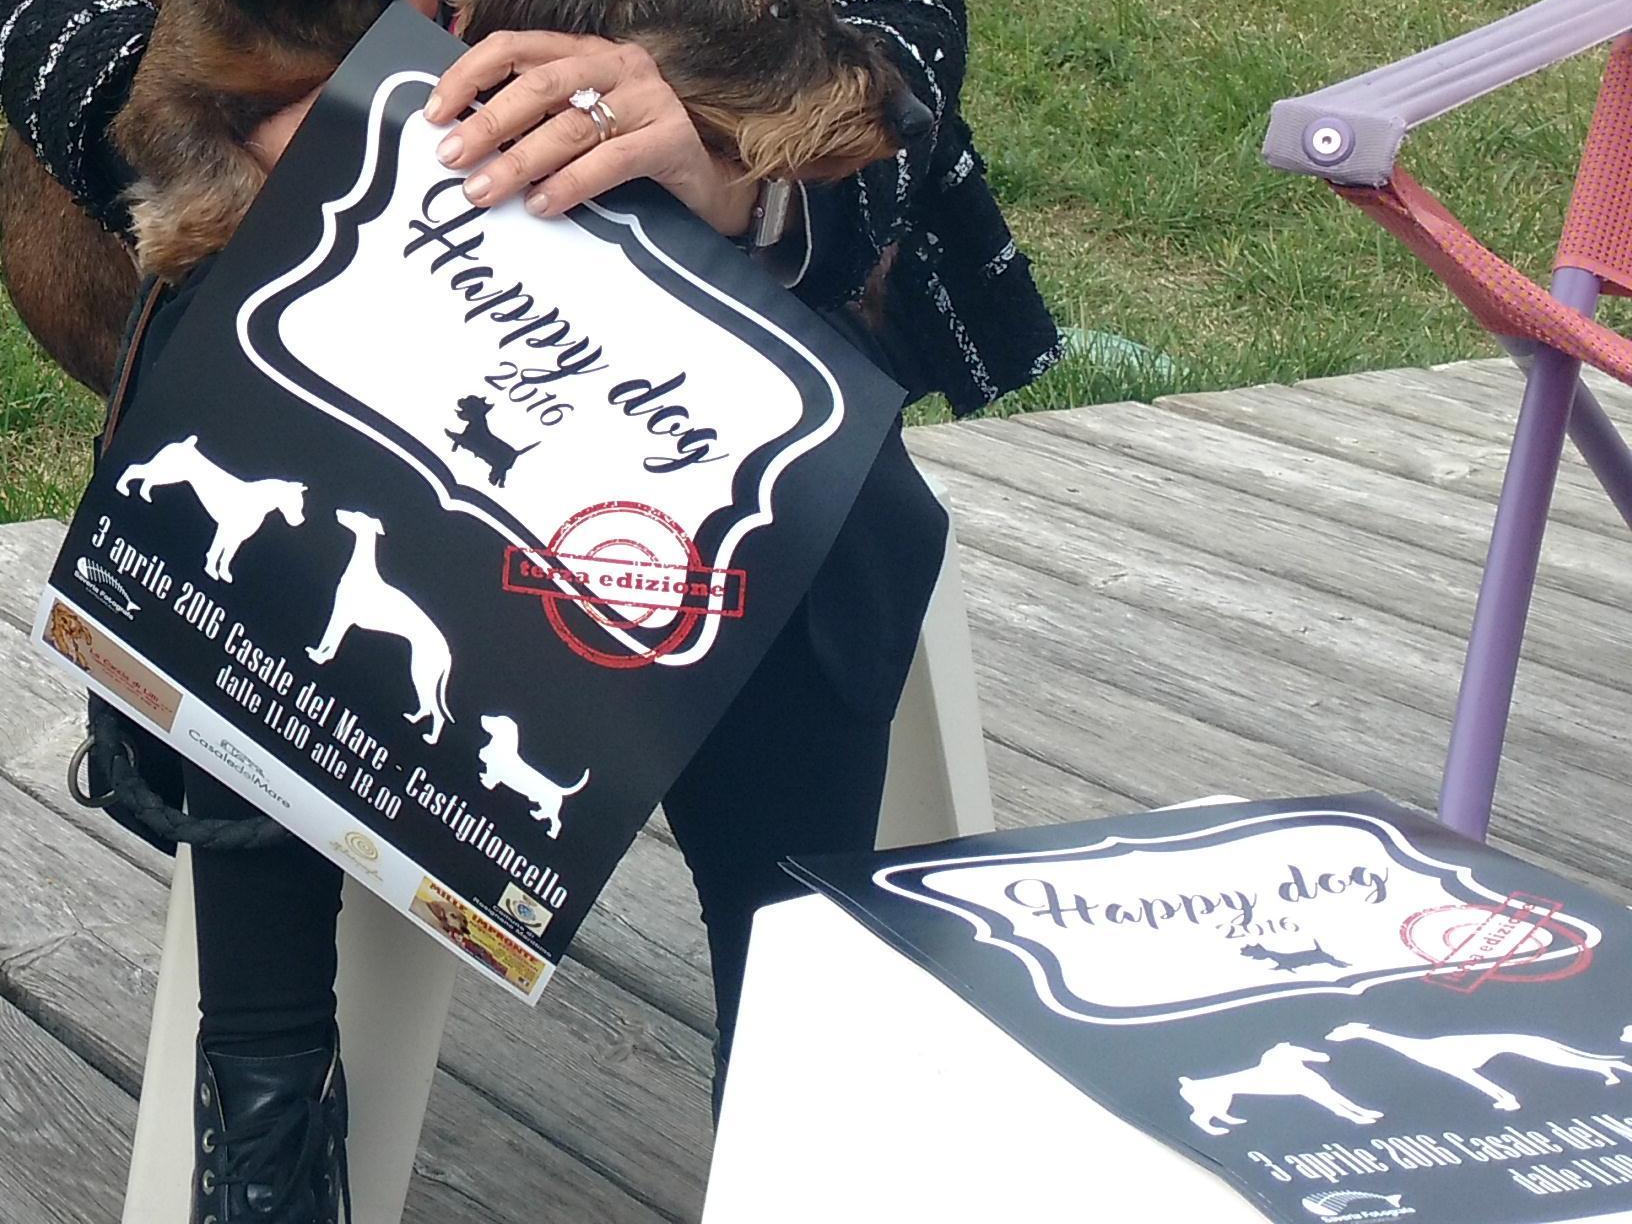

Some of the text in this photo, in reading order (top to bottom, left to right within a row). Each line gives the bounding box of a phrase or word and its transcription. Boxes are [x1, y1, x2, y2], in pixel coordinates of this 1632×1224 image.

[403, 177, 729, 473] Happy dog
[484, 361, 574, 426] 2016
[520, 561, 726, 597] terza edizione
[91, 515, 111, 548] 3
[109, 537, 172, 600] aprile
[173, 581, 227, 640] 2016
[224, 622, 294, 696] Casale
[295, 682, 336, 727] del
[332, 708, 389, 772] Mare
[405, 766, 568, 909] Castiglioncello
[215, 665, 263, 714] dalle
[264, 699, 311, 750] 11.00
[310, 742, 348, 780] alle
[350, 768, 402, 821] 18.00
[1003, 864, 1389, 930] Happy dog
[1215, 916, 1300, 939] 2016
[1247, 1150, 1293, 1182] 3
[1285, 1143, 1389, 1184] aprile
[1370, 1133, 1463, 1169] 2016
[1443, 1126, 1564, 1162] Casale
[1545, 1118, 1618, 1150] del
[1507, 1164, 1593, 1194] dalle
